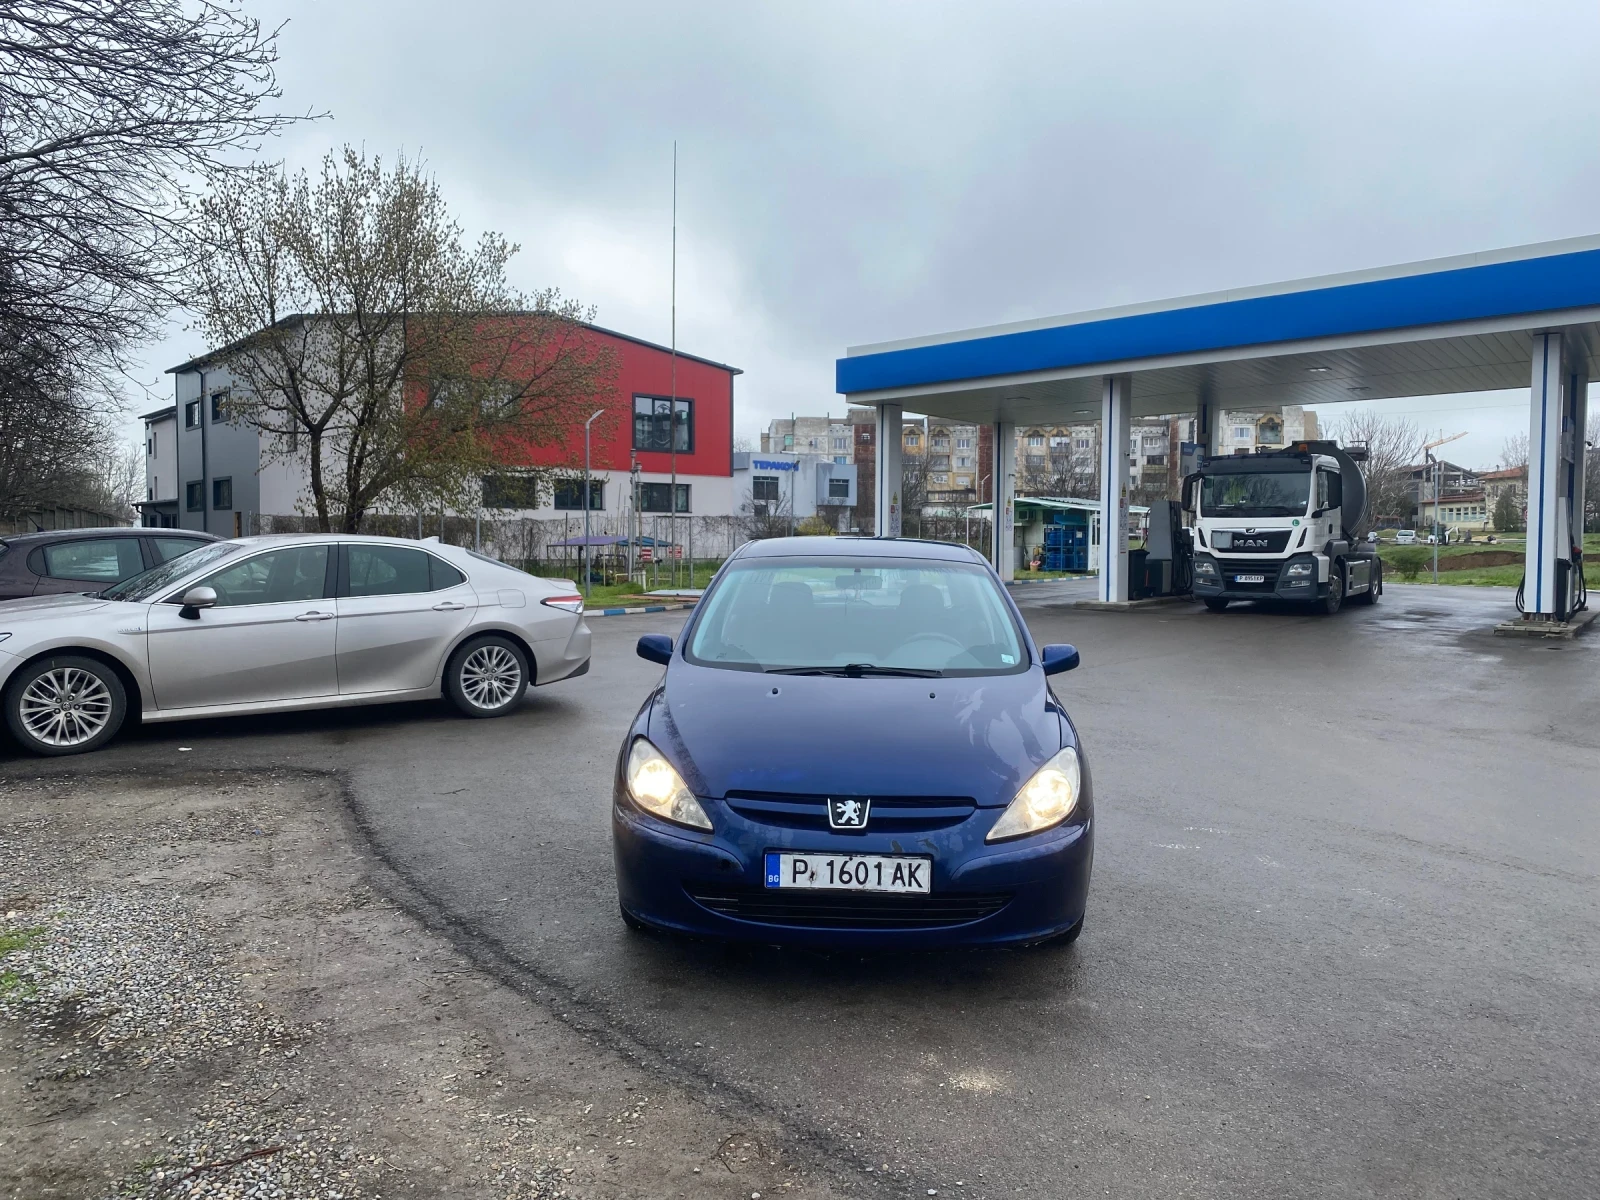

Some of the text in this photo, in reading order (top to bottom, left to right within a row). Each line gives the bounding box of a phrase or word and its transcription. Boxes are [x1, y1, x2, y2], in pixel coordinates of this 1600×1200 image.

[1233, 539, 1268, 547] MAN
[792, 859, 923, 888] P 1601 AK
[768, 874, 779, 883] BG
